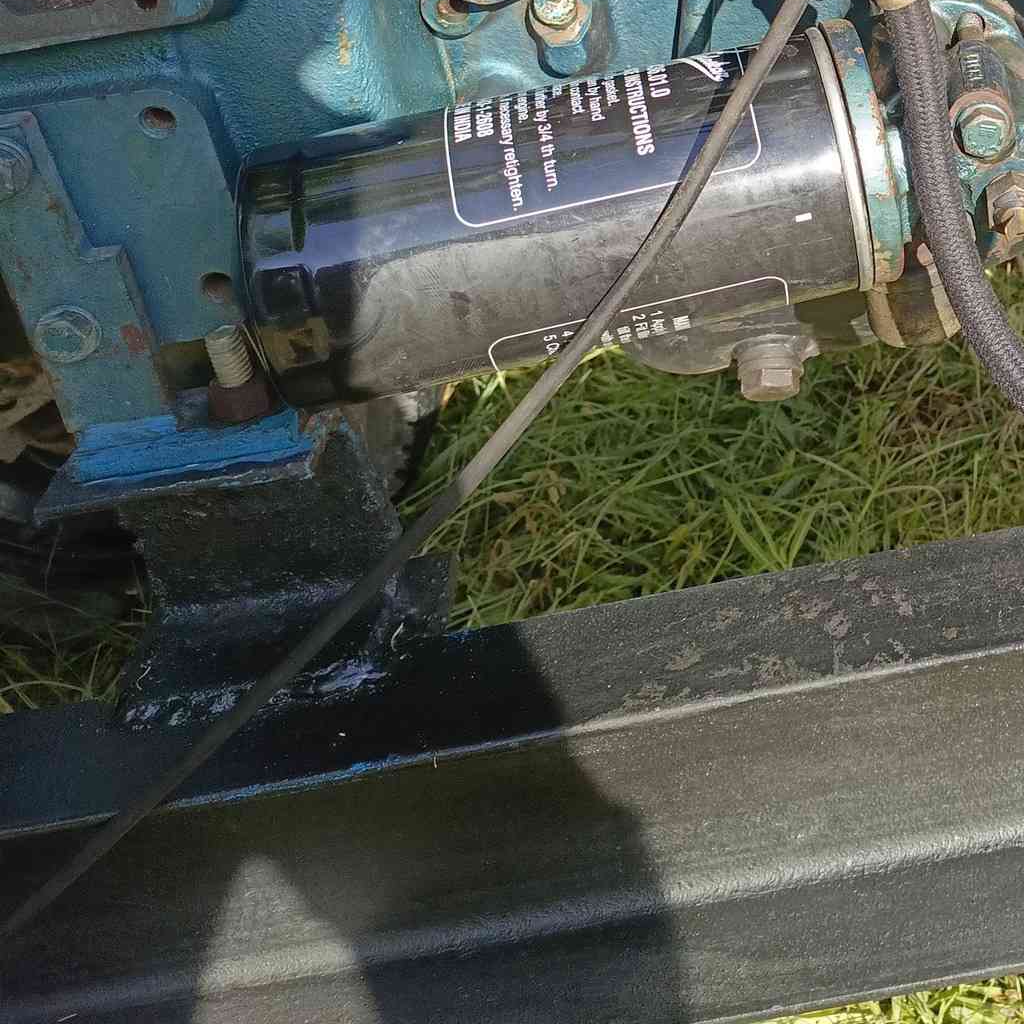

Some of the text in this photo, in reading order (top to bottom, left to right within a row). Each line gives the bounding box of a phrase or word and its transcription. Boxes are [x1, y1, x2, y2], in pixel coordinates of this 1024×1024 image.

[585, 86, 600, 96] by
[499, 101, 513, 145] necessary
[533, 109, 549, 122] by
[589, 96, 606, 122] hand
[624, 75, 656, 156] INSTRUCTIONS
[454, 114, 473, 144] INDIA
[538, 123, 553, 142] 3/4
[541, 145, 553, 158] th
[503, 146, 525, 212] retighten.
[543, 160, 558, 192] turn.
